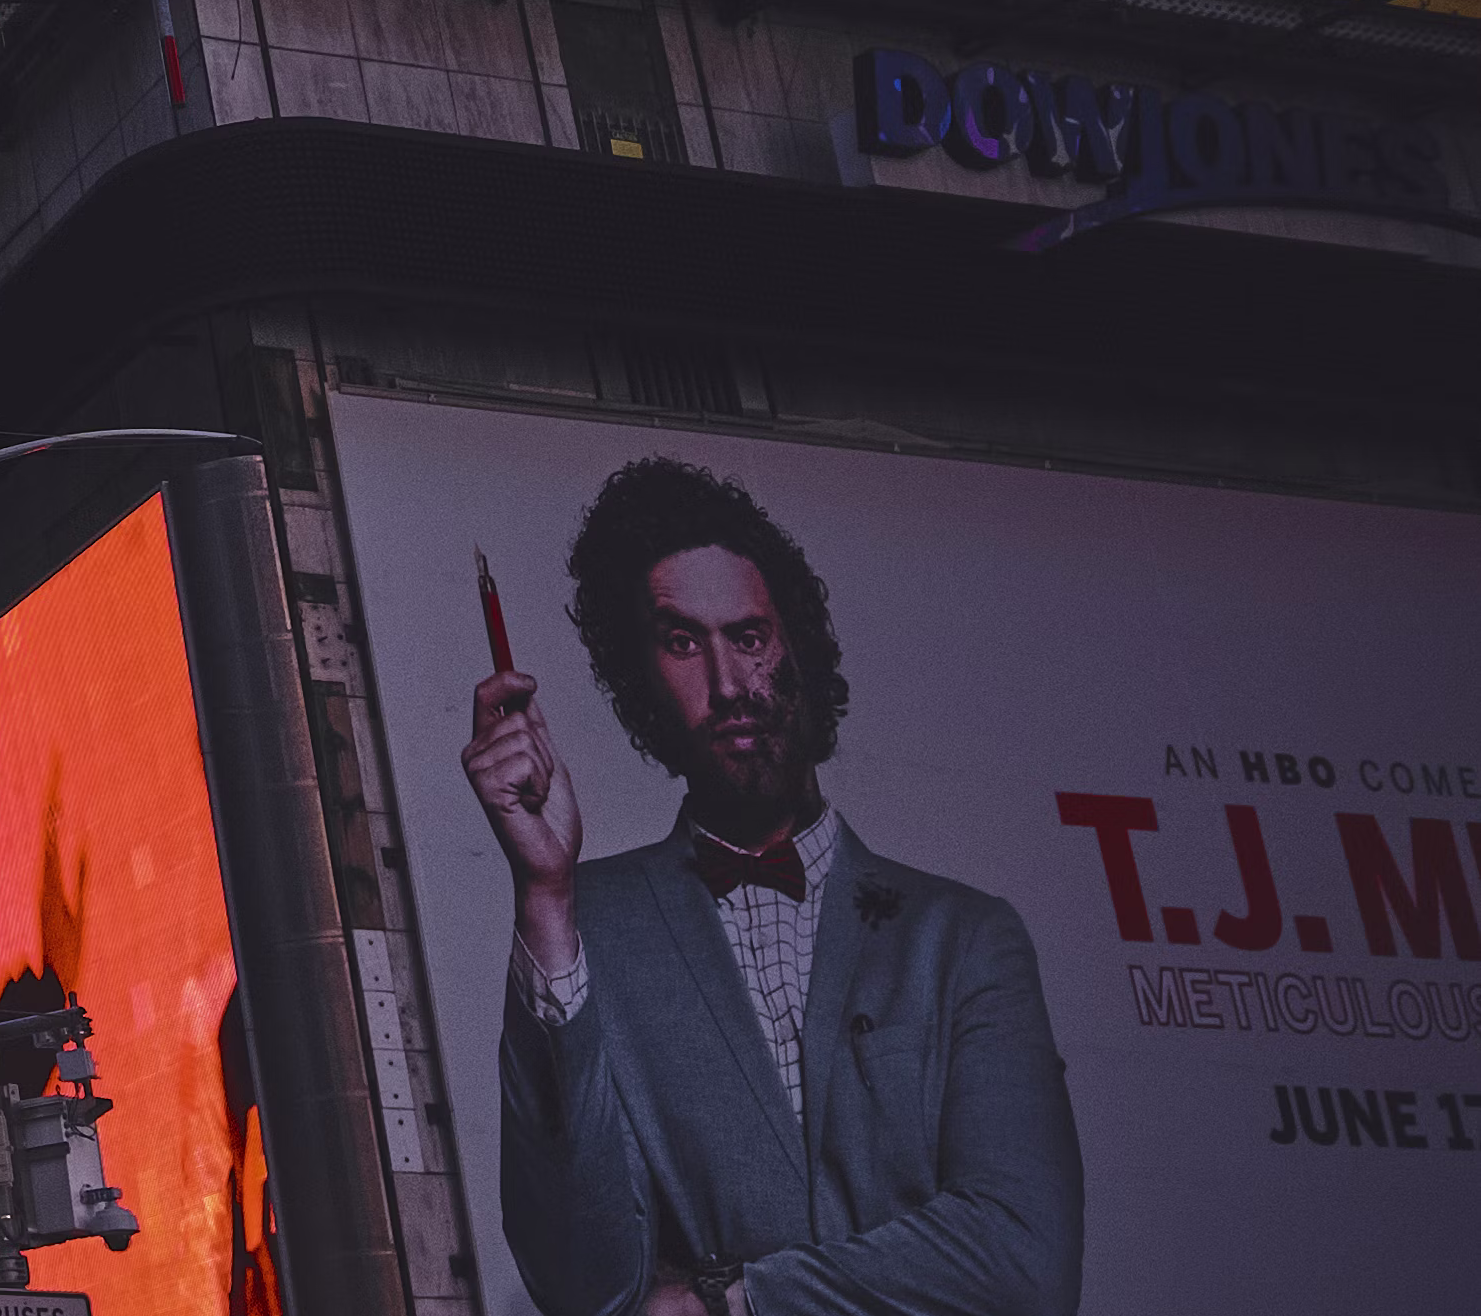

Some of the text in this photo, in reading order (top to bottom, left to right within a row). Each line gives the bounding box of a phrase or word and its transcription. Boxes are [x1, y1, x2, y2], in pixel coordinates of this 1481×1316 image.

[853, 47, 1449, 218] DOW JONES
[1165, 744, 1219, 780] AN
[1239, 750, 1336, 788] HBO
[1270, 1085, 1428, 1150] JUNE
